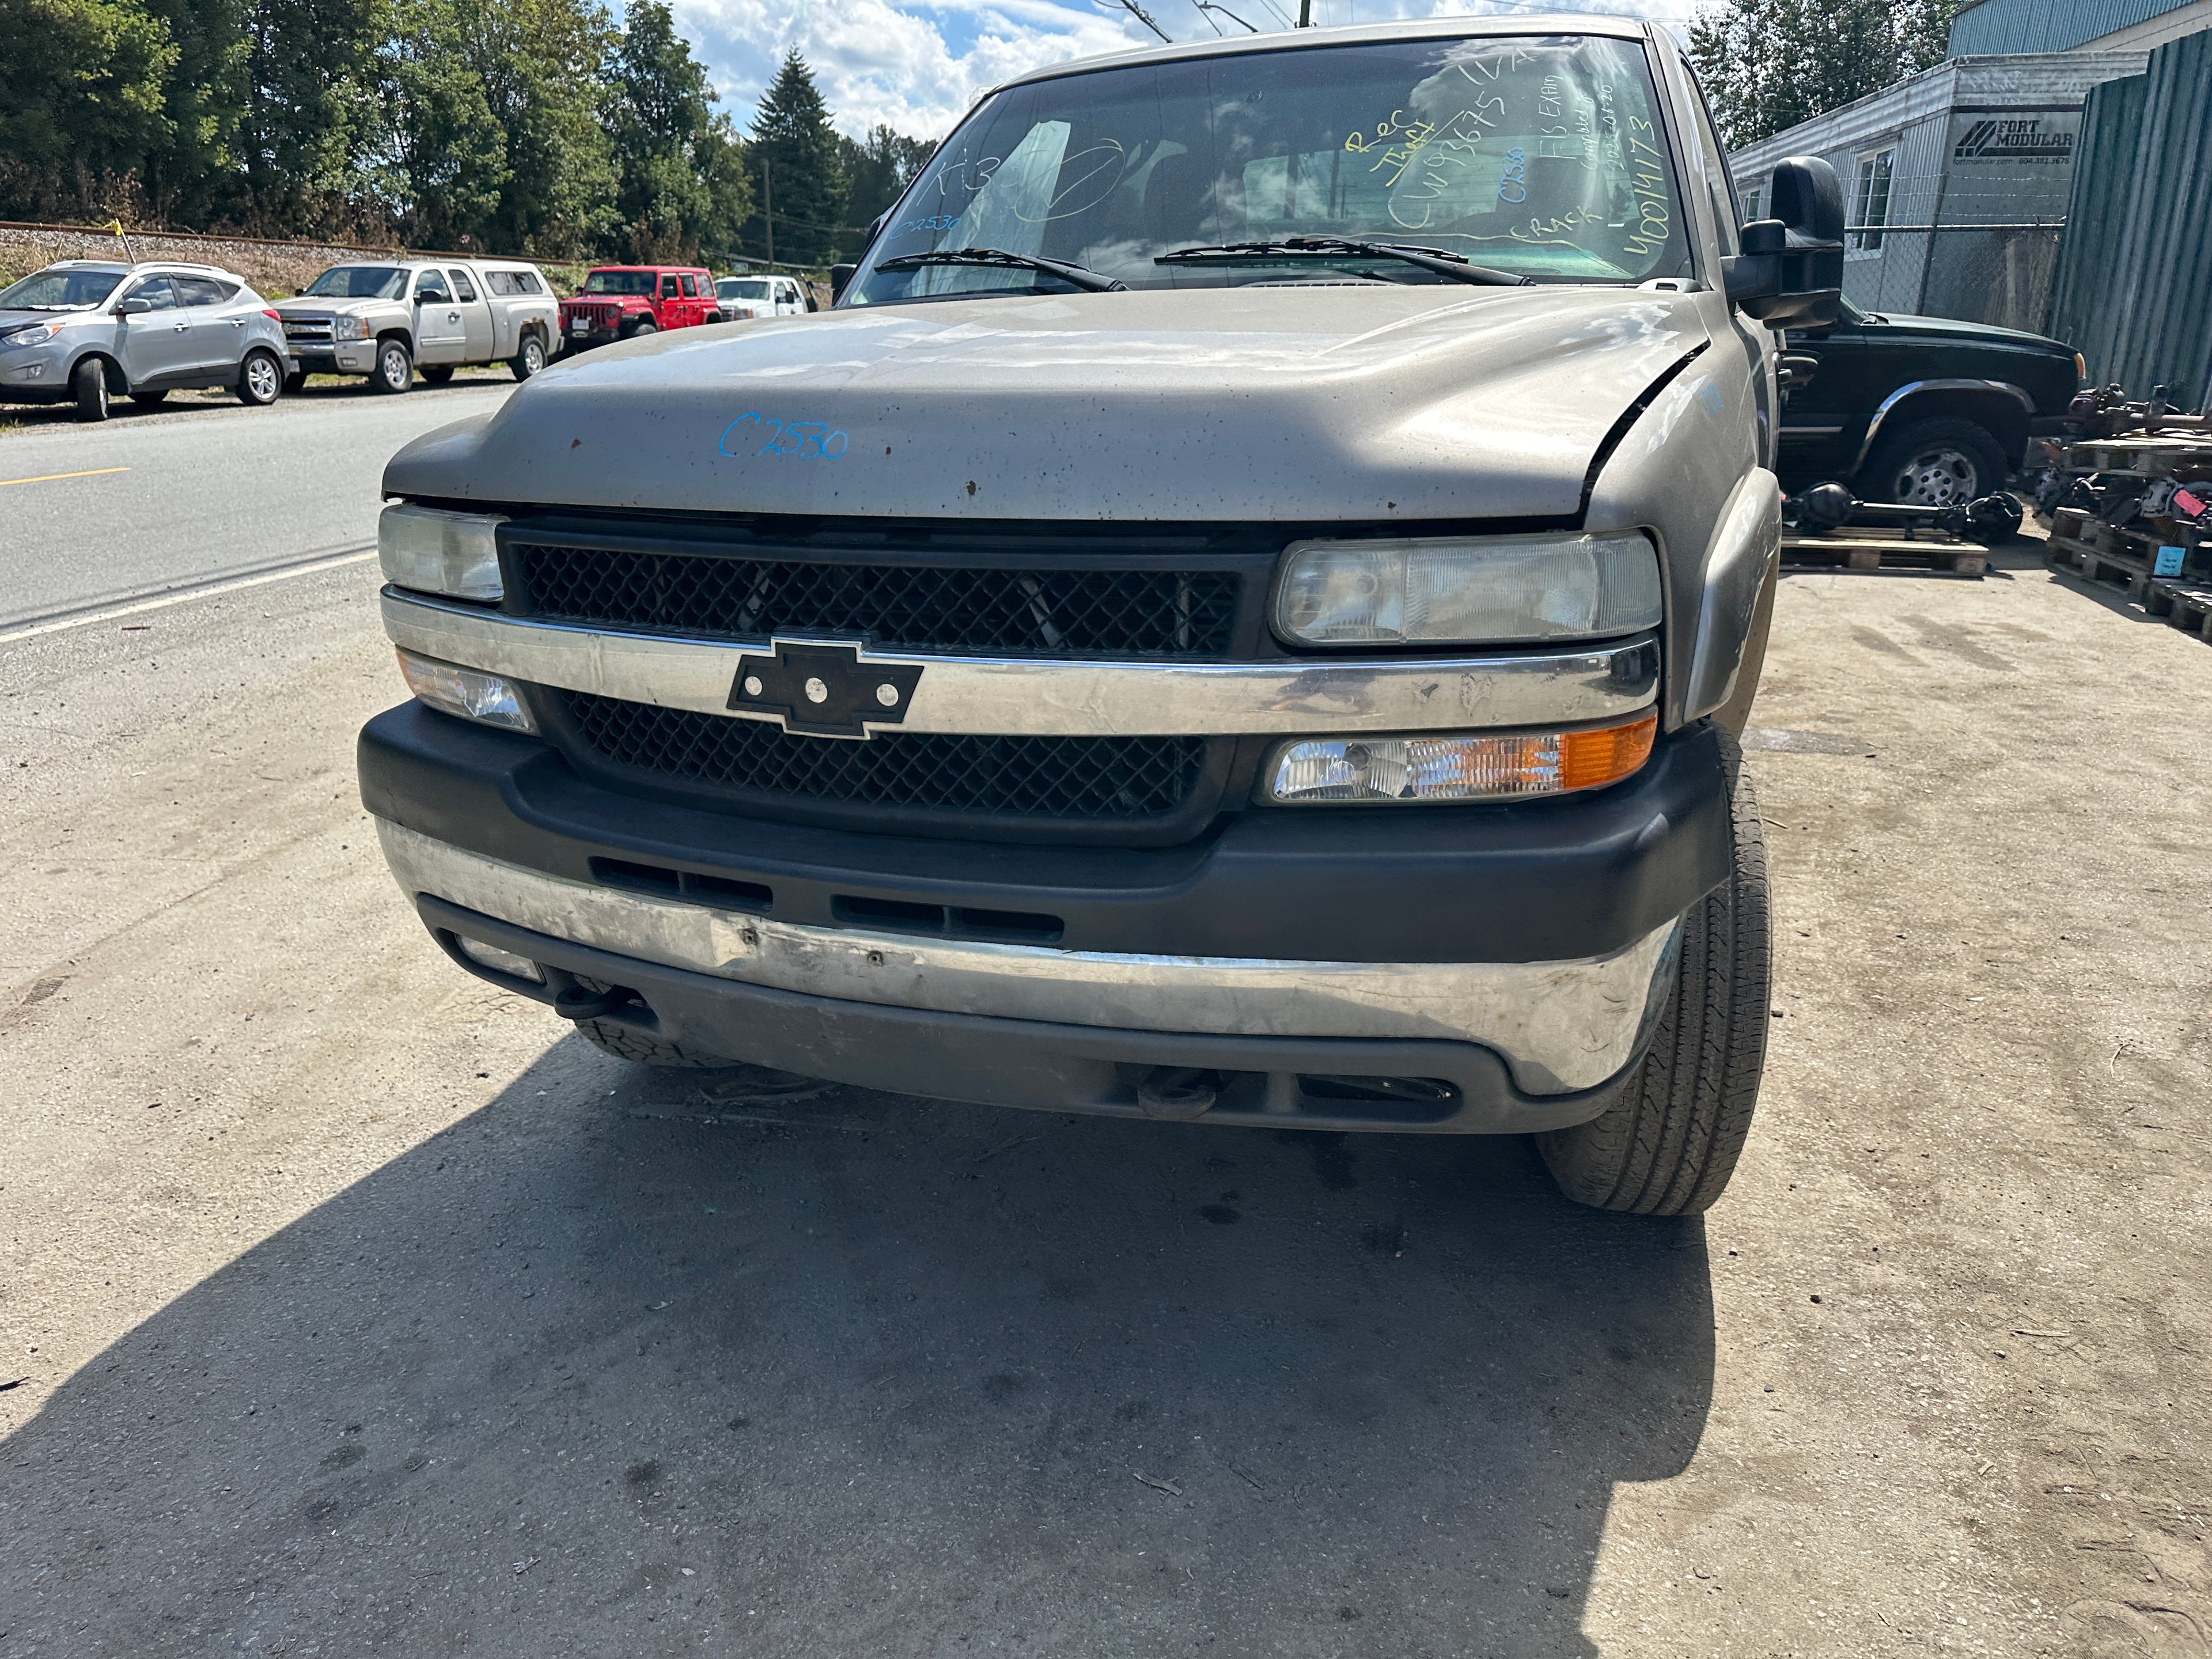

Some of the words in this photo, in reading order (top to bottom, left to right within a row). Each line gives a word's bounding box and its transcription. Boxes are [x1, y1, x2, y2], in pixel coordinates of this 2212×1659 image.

[1997, 120, 2040, 133] FORT
[1995, 132, 2074, 146] MODULAR
[718, 411, 848, 460] C2530
